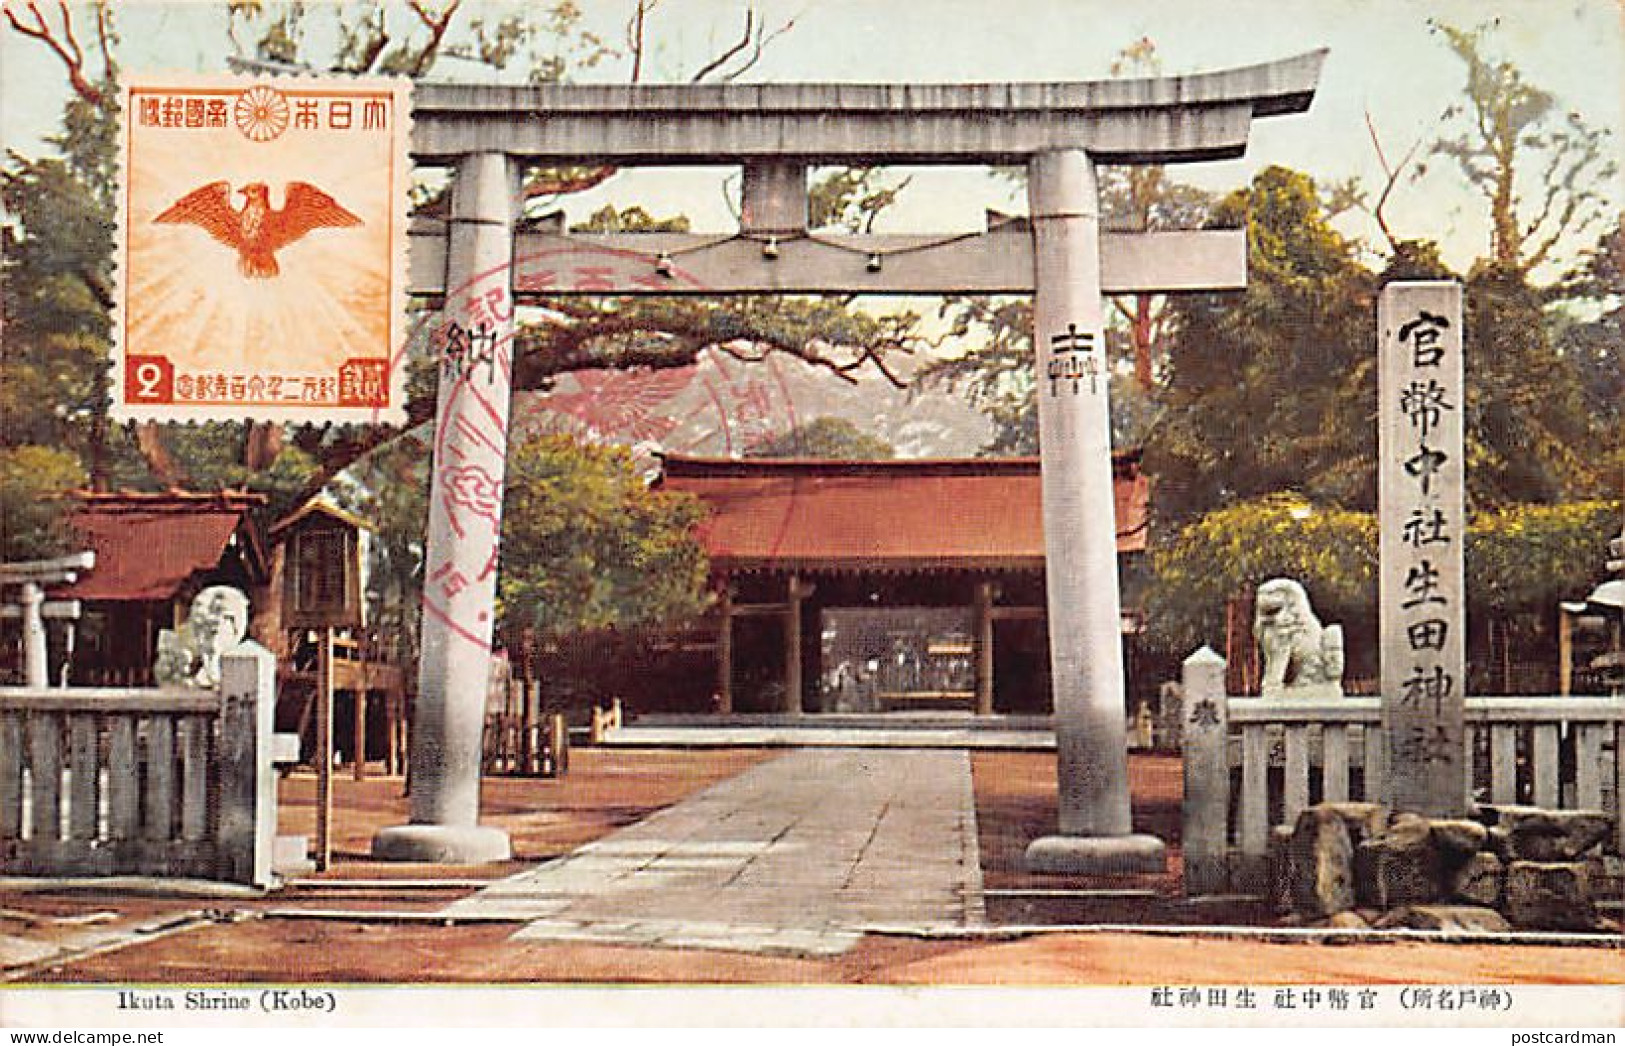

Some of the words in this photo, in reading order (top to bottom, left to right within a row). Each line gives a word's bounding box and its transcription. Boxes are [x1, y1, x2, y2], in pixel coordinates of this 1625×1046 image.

[136, 363, 162, 398] 2
[117, 991, 175, 1010] Ikuta
[184, 991, 251, 1010] Shrine
[259, 989, 336, 1013] (Kobe)
